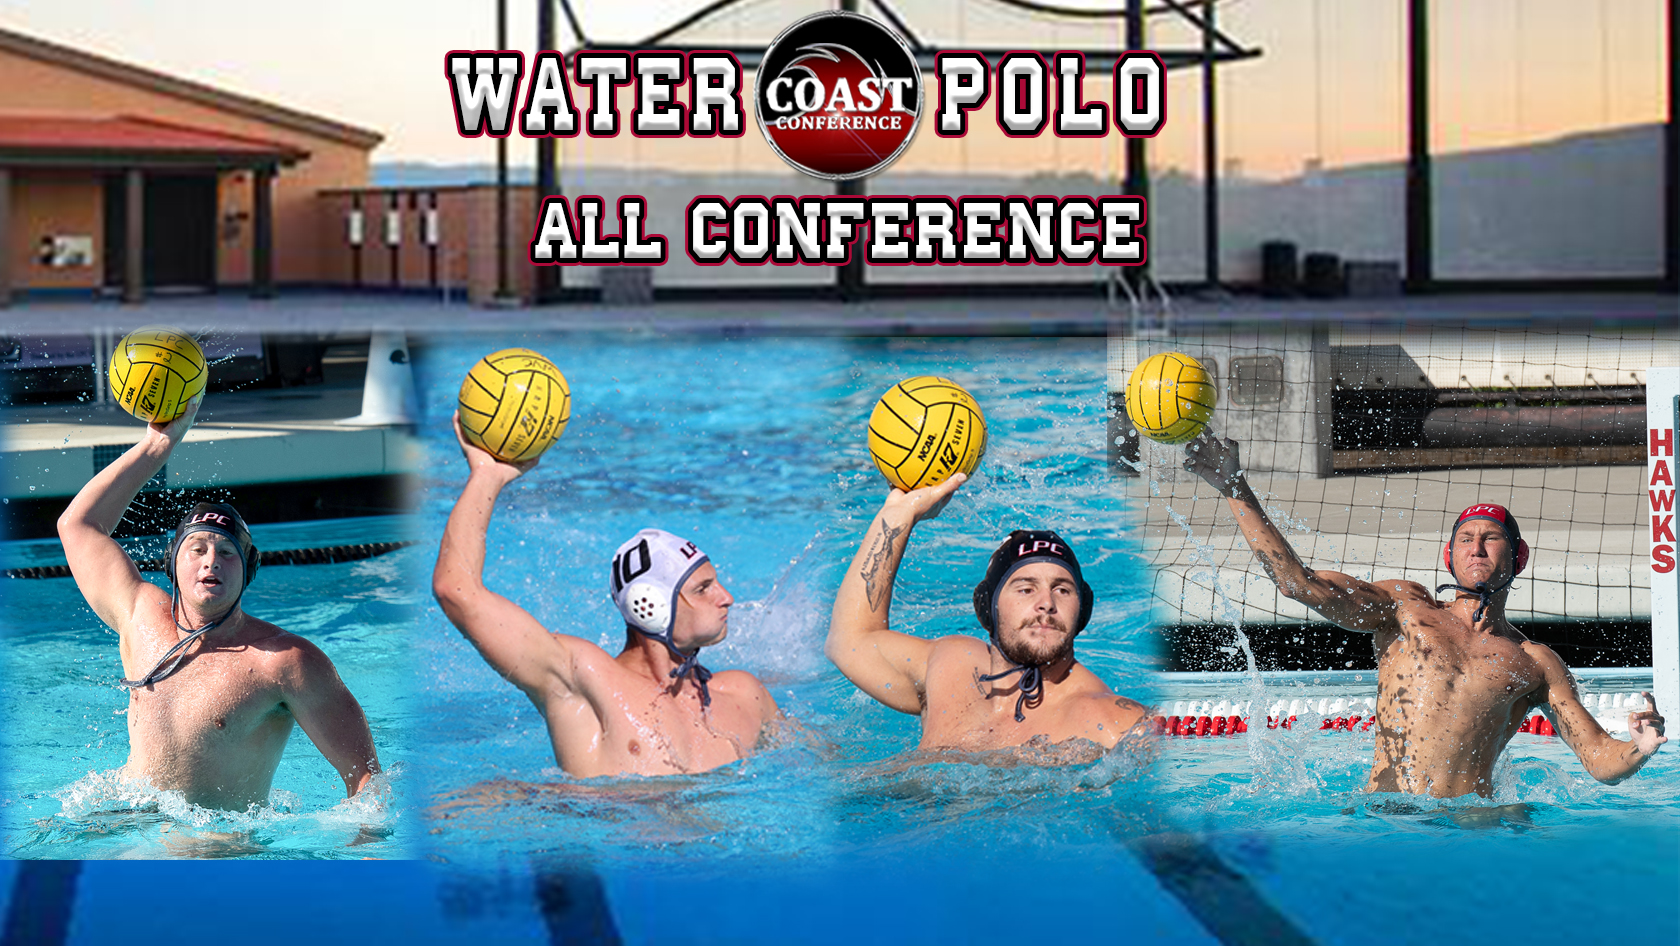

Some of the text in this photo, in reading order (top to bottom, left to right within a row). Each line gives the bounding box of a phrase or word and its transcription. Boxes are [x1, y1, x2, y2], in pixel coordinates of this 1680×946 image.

[154, 332, 184, 350] LPC
[125, 387, 135, 405] NCAA
[149, 377, 160, 398] SEVEN
[951, 419, 964, 445] SEVEN
[917, 434, 935, 462] NCAA
[1465, 505, 1500, 516] LPC
[1649, 428, 1676, 574] HAWKS
[190, 512, 231, 526] LPC
[680, 541, 697, 560] LP
[1018, 540, 1065, 557] LPC
[612, 538, 652, 594] 10
